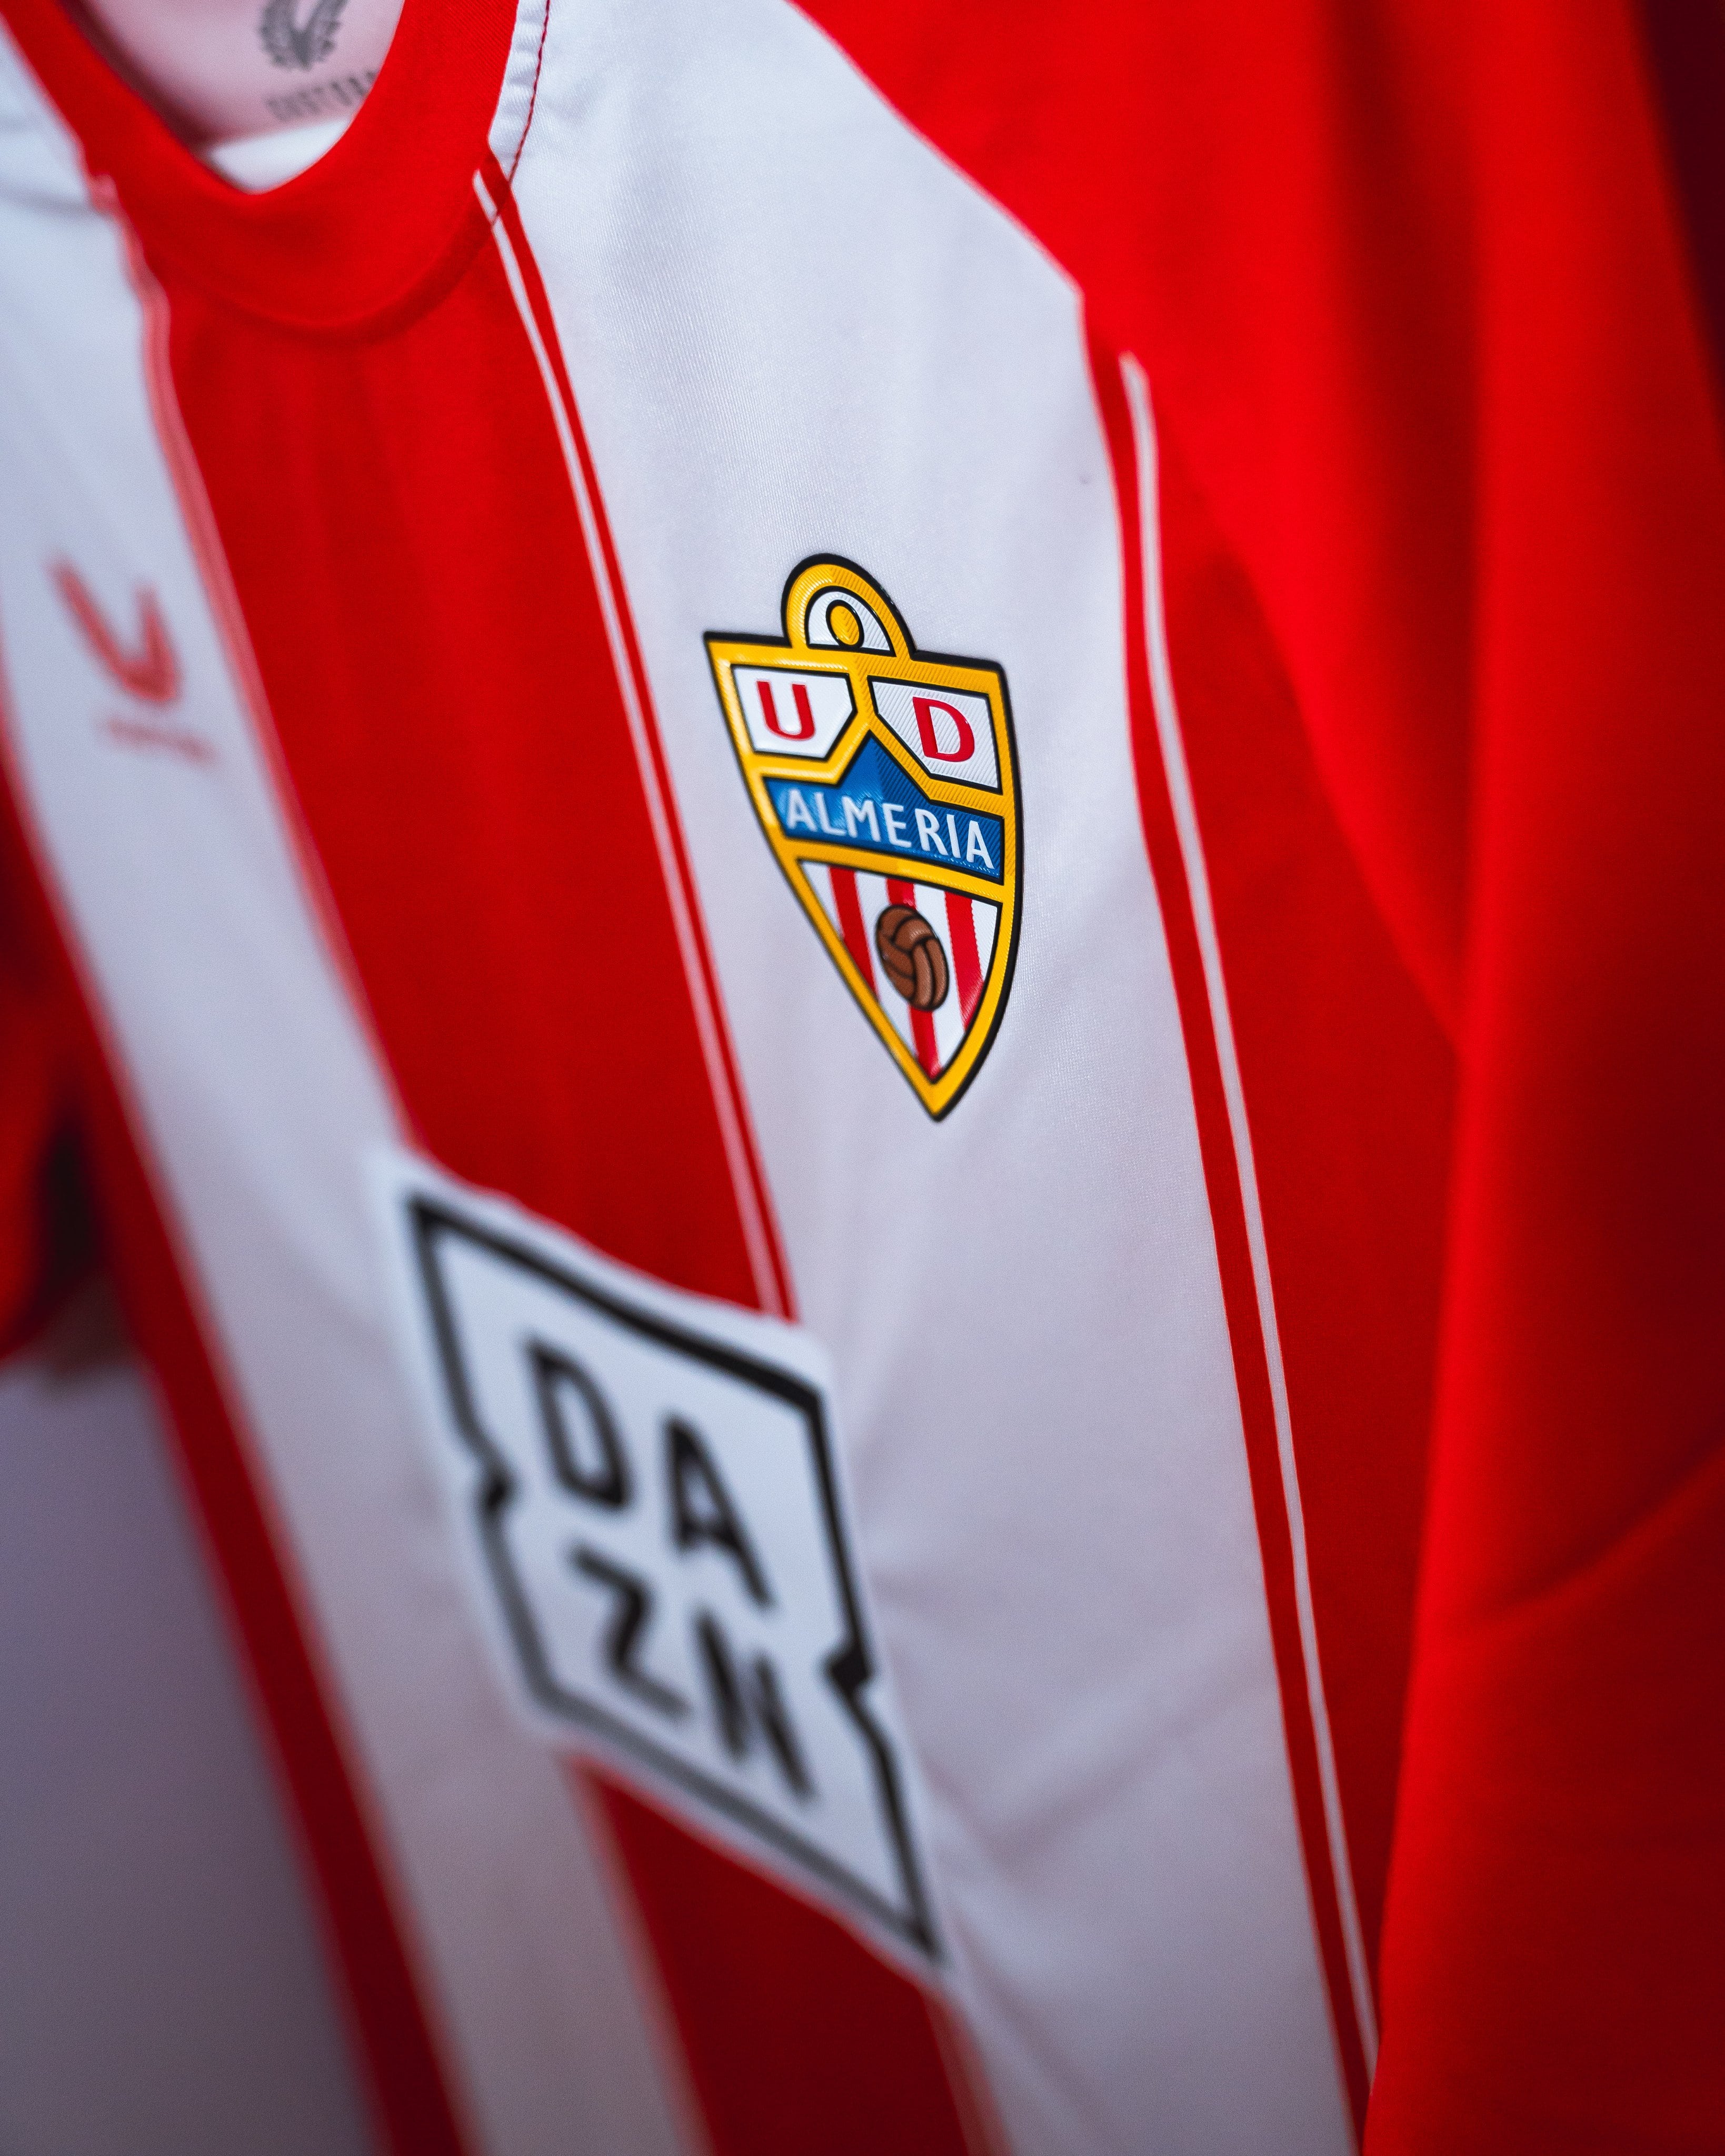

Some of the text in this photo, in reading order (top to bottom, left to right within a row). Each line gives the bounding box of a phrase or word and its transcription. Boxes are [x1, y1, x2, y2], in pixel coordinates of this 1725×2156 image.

[755, 680, 975, 762] U D
[786, 788, 994, 870] ALMERIA
